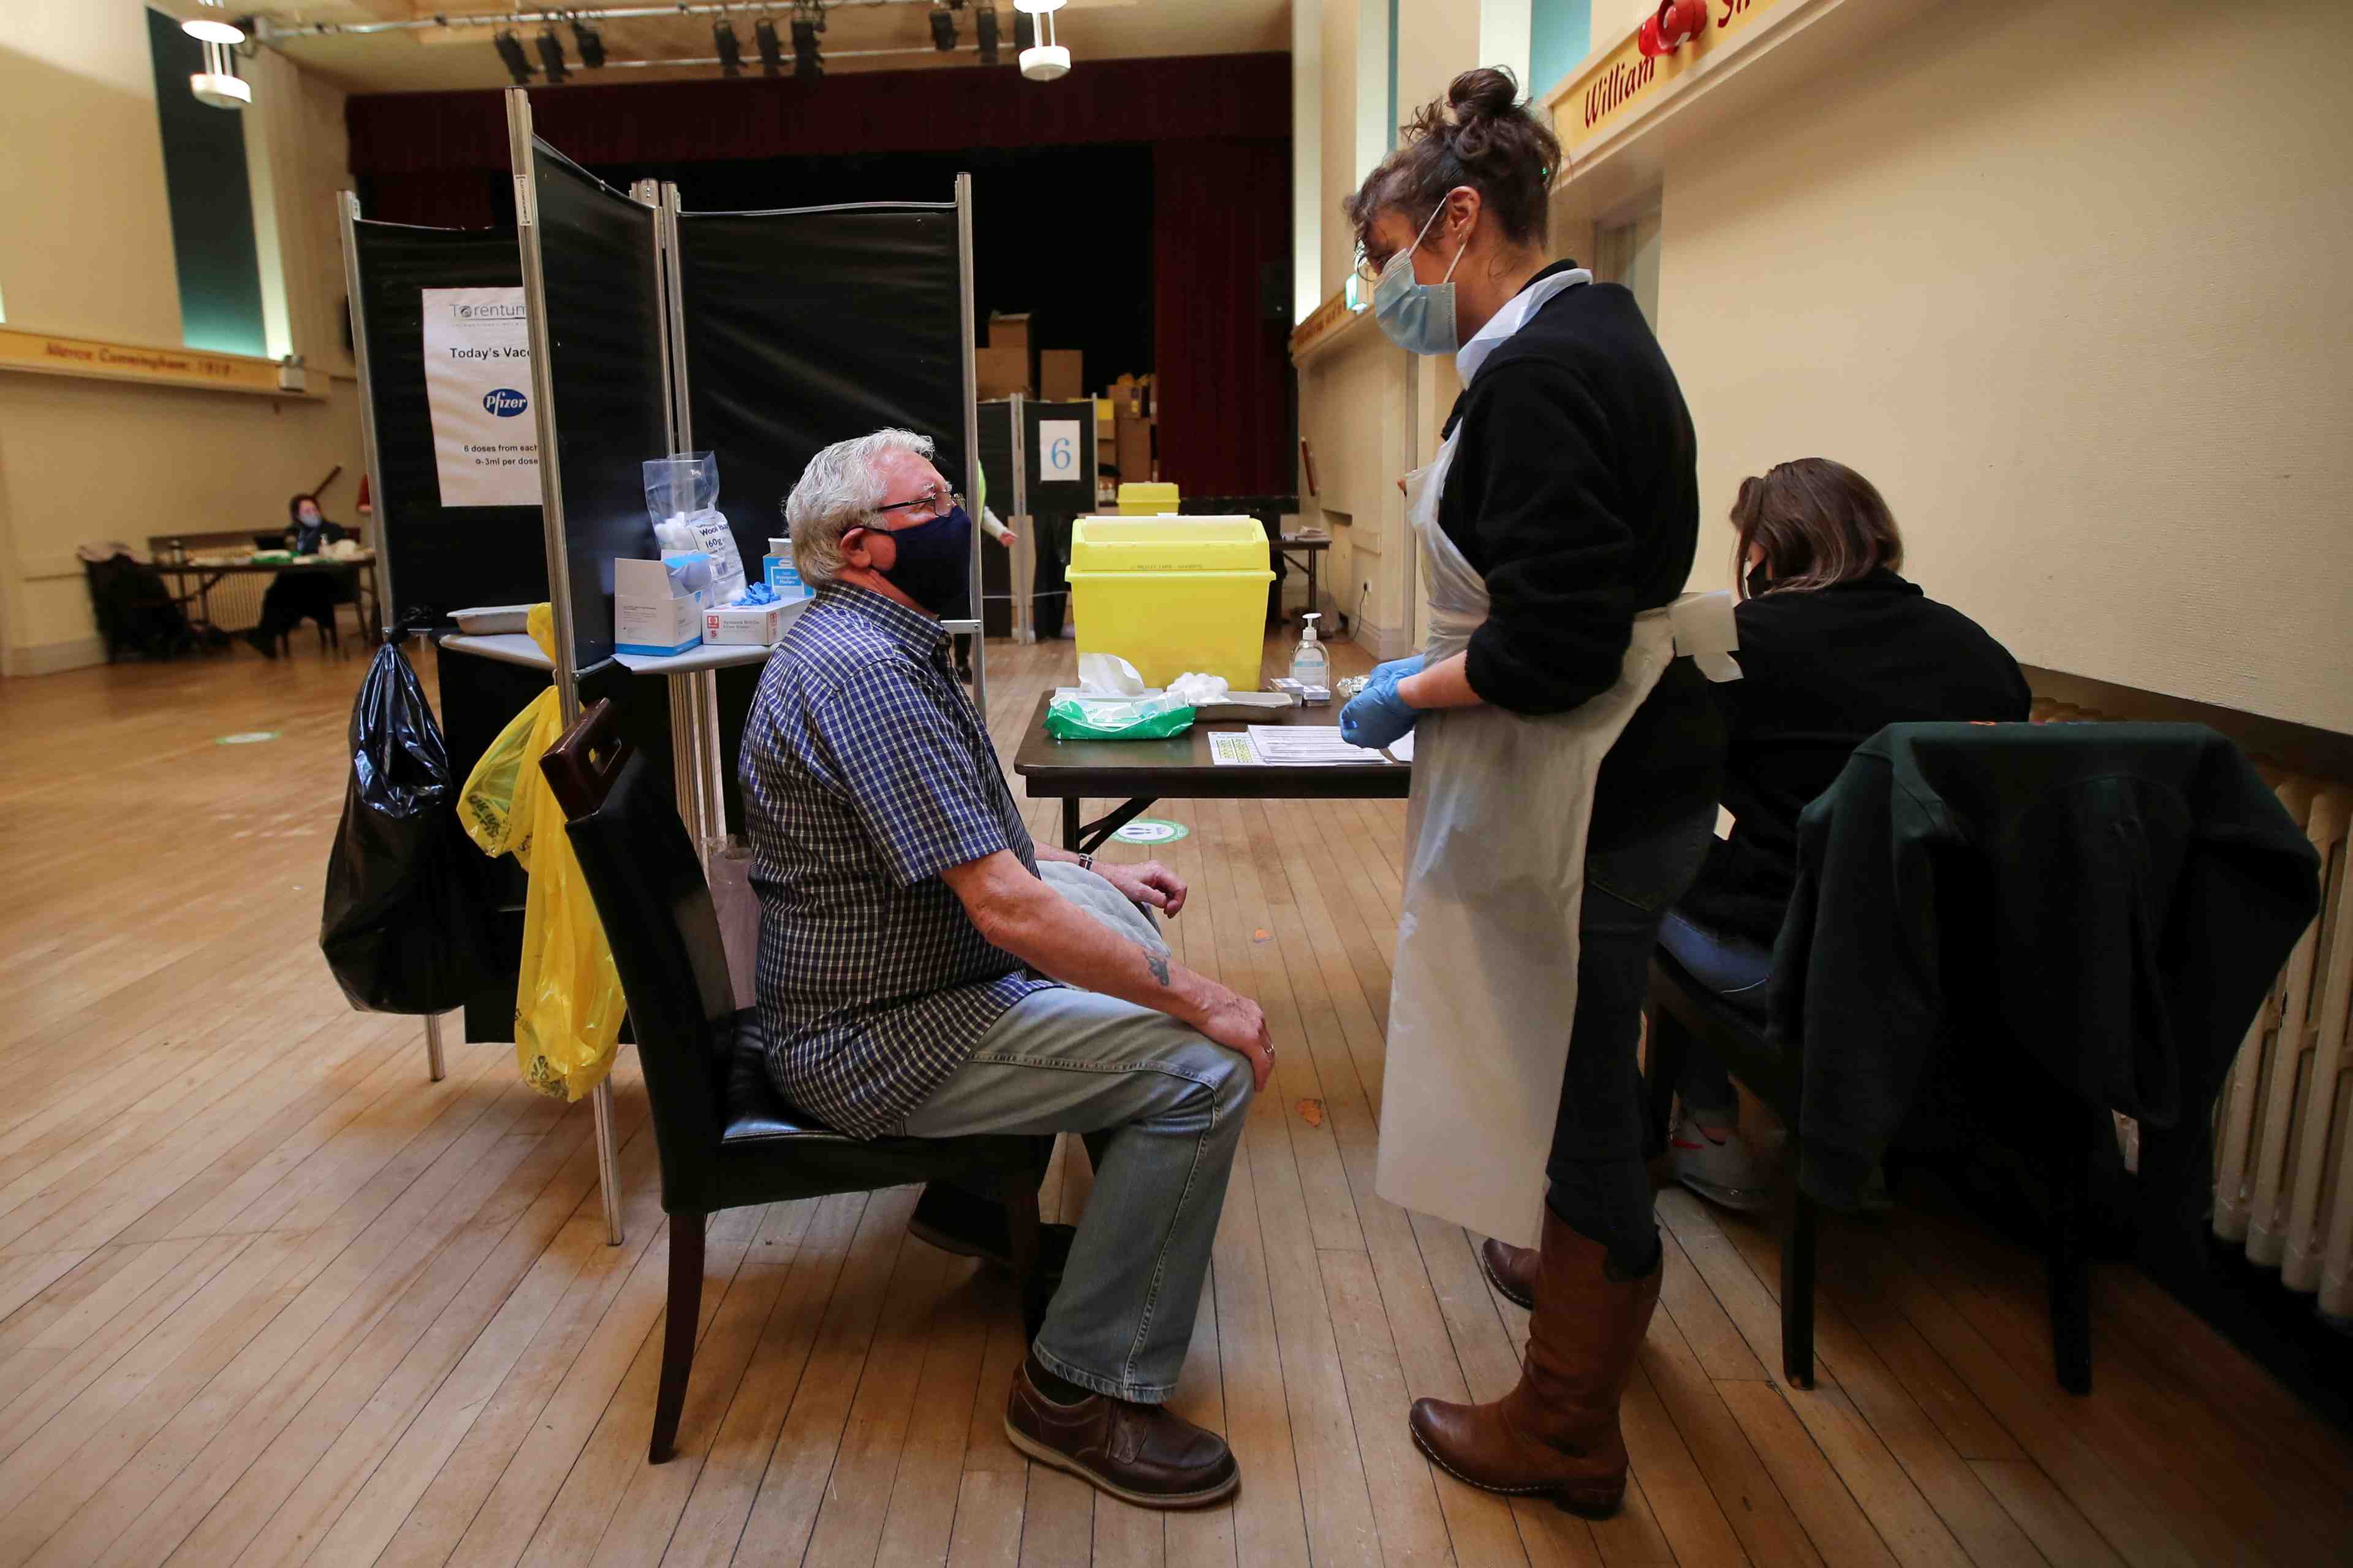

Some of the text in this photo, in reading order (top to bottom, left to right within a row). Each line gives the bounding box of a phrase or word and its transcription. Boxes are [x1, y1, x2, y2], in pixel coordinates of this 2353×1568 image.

[1585, 55, 1654, 129] William
[450, 347, 500, 360] Today's
[486, 392, 527, 416] Pfizer
[1051, 437, 1071, 469] 6
[700, 526, 718, 536] Wool
[705, 538, 724, 549] 160g
